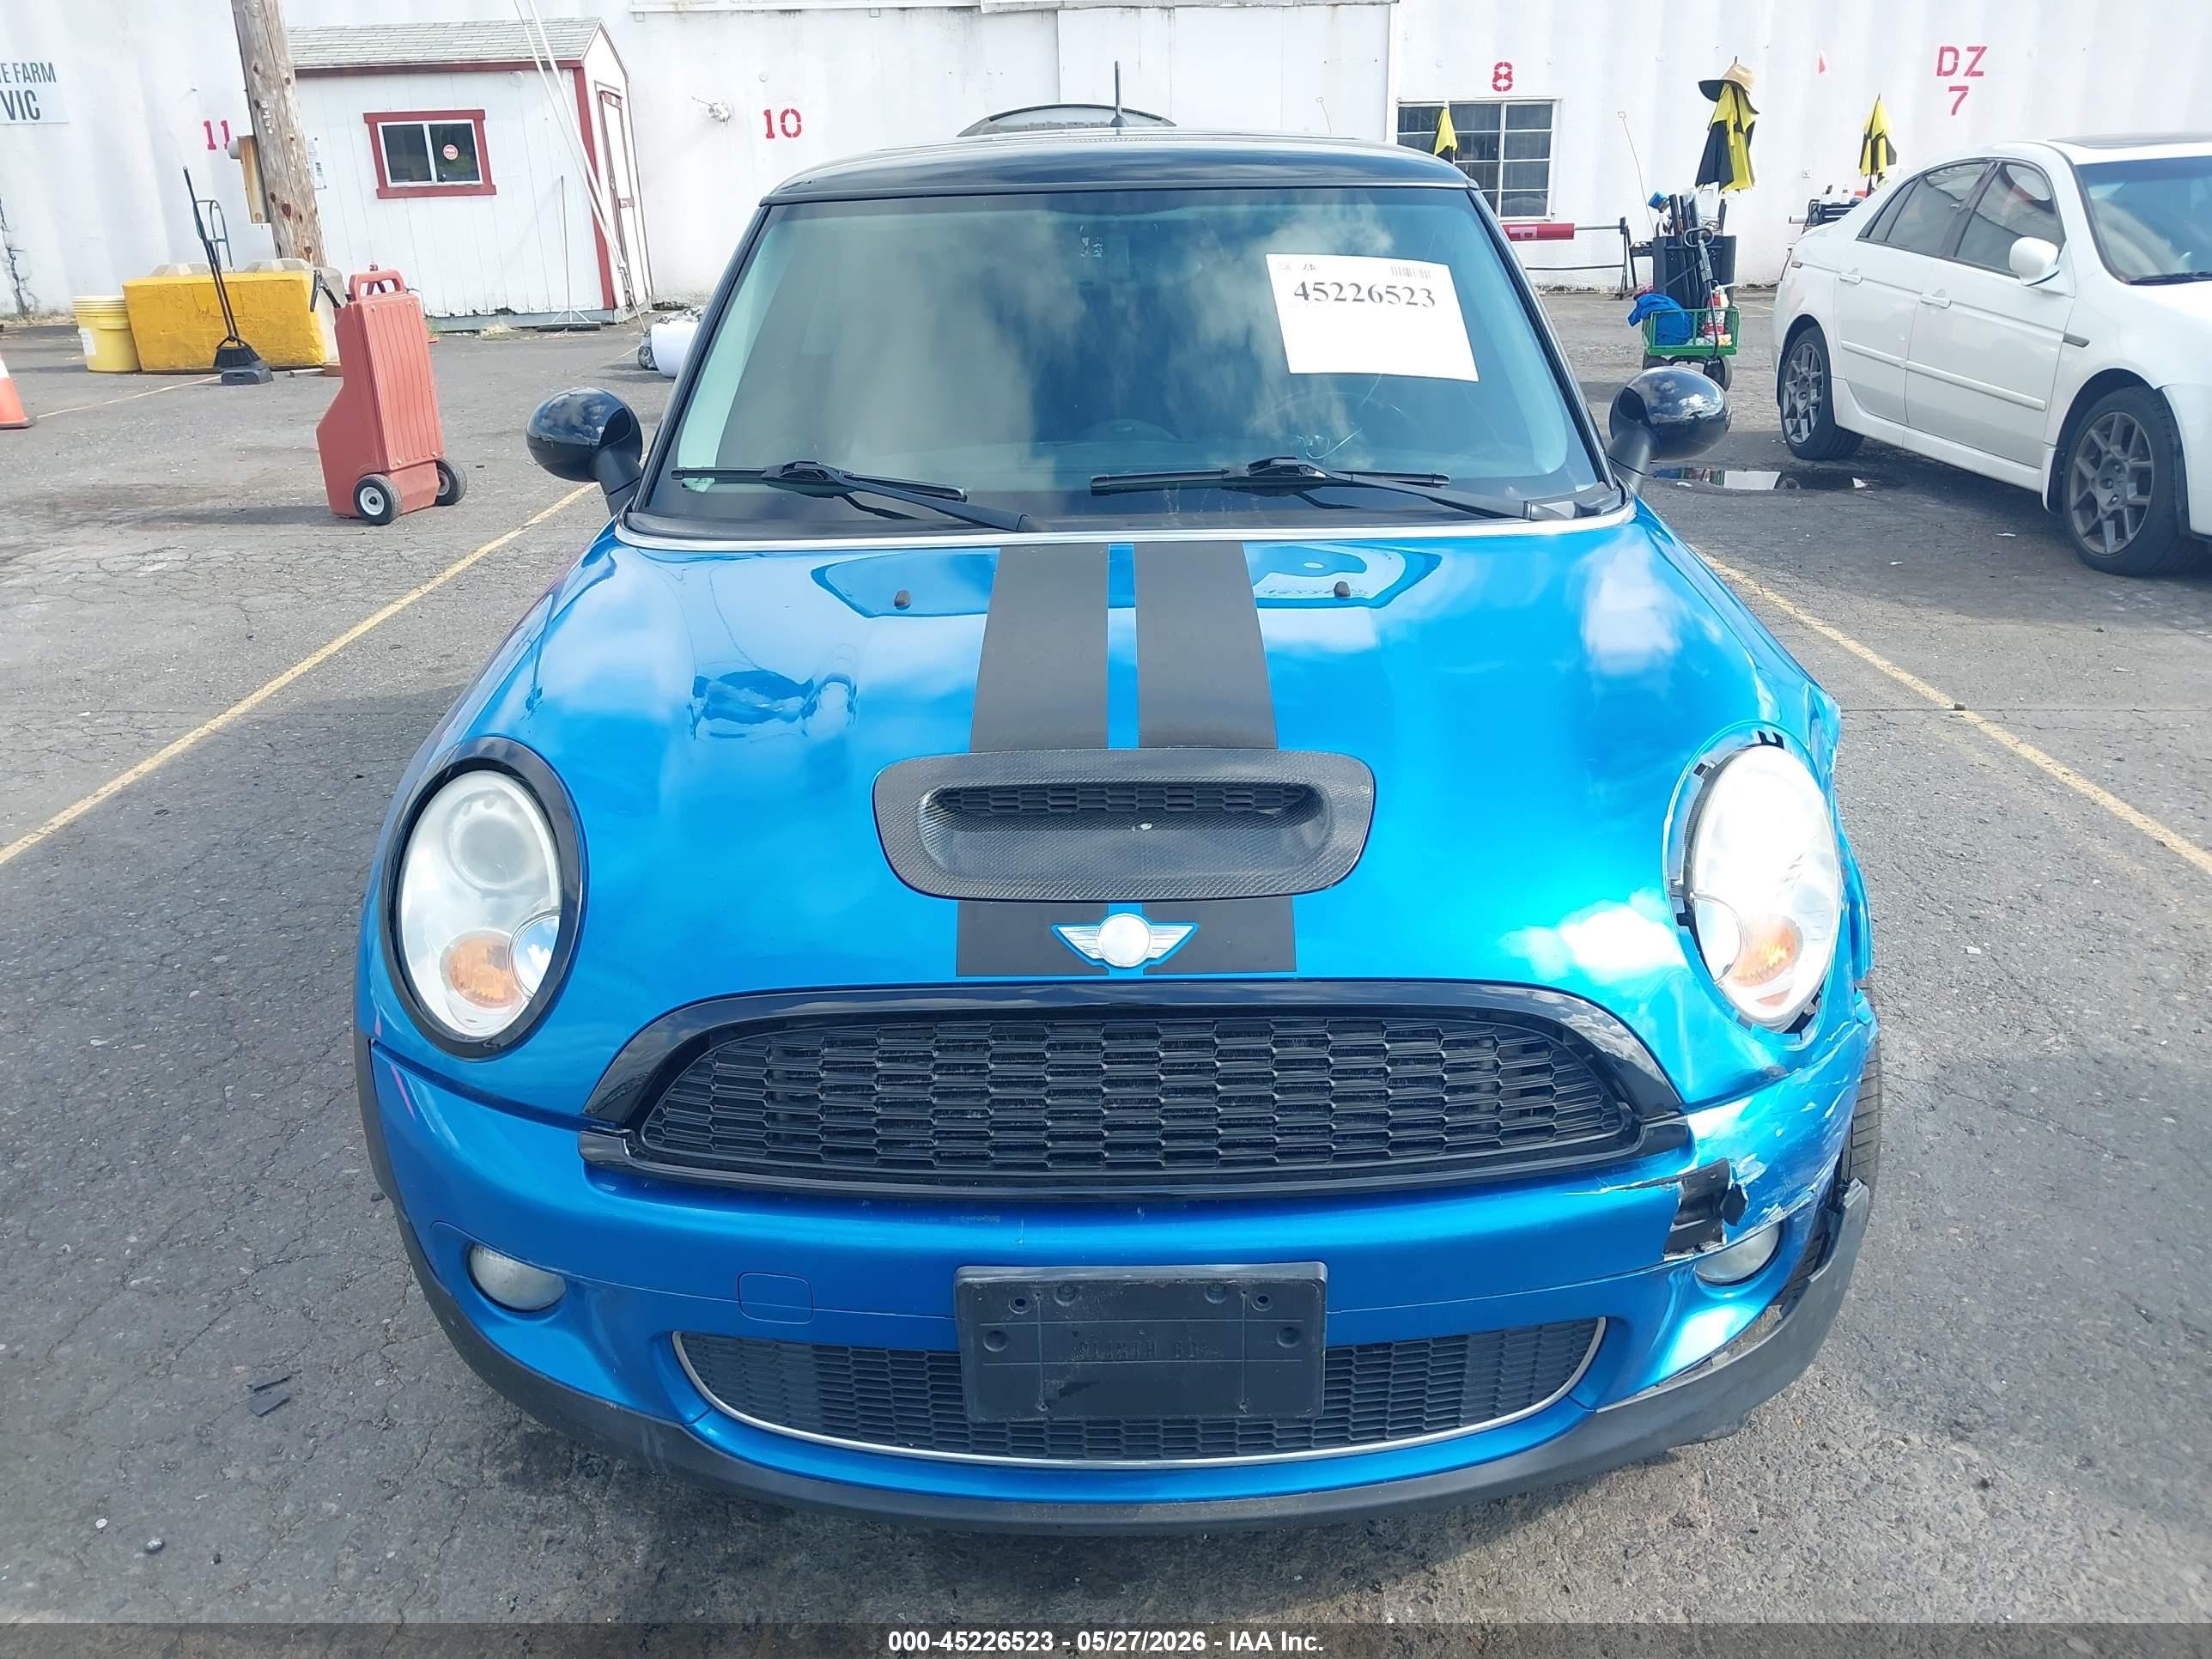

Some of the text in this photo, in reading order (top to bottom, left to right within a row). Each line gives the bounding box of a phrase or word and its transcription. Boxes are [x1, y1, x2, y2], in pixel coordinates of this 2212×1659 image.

[0, 62, 57, 83] E FARM
[1492, 61, 1513, 92] 8
[1936, 46, 1988, 77] DZ
[0, 89, 41, 121] VIC
[1948, 85, 1969, 116] 7
[203, 119, 230, 150] 11
[763, 108, 802, 139] 10
[1293, 280, 1436, 308] 45226523
